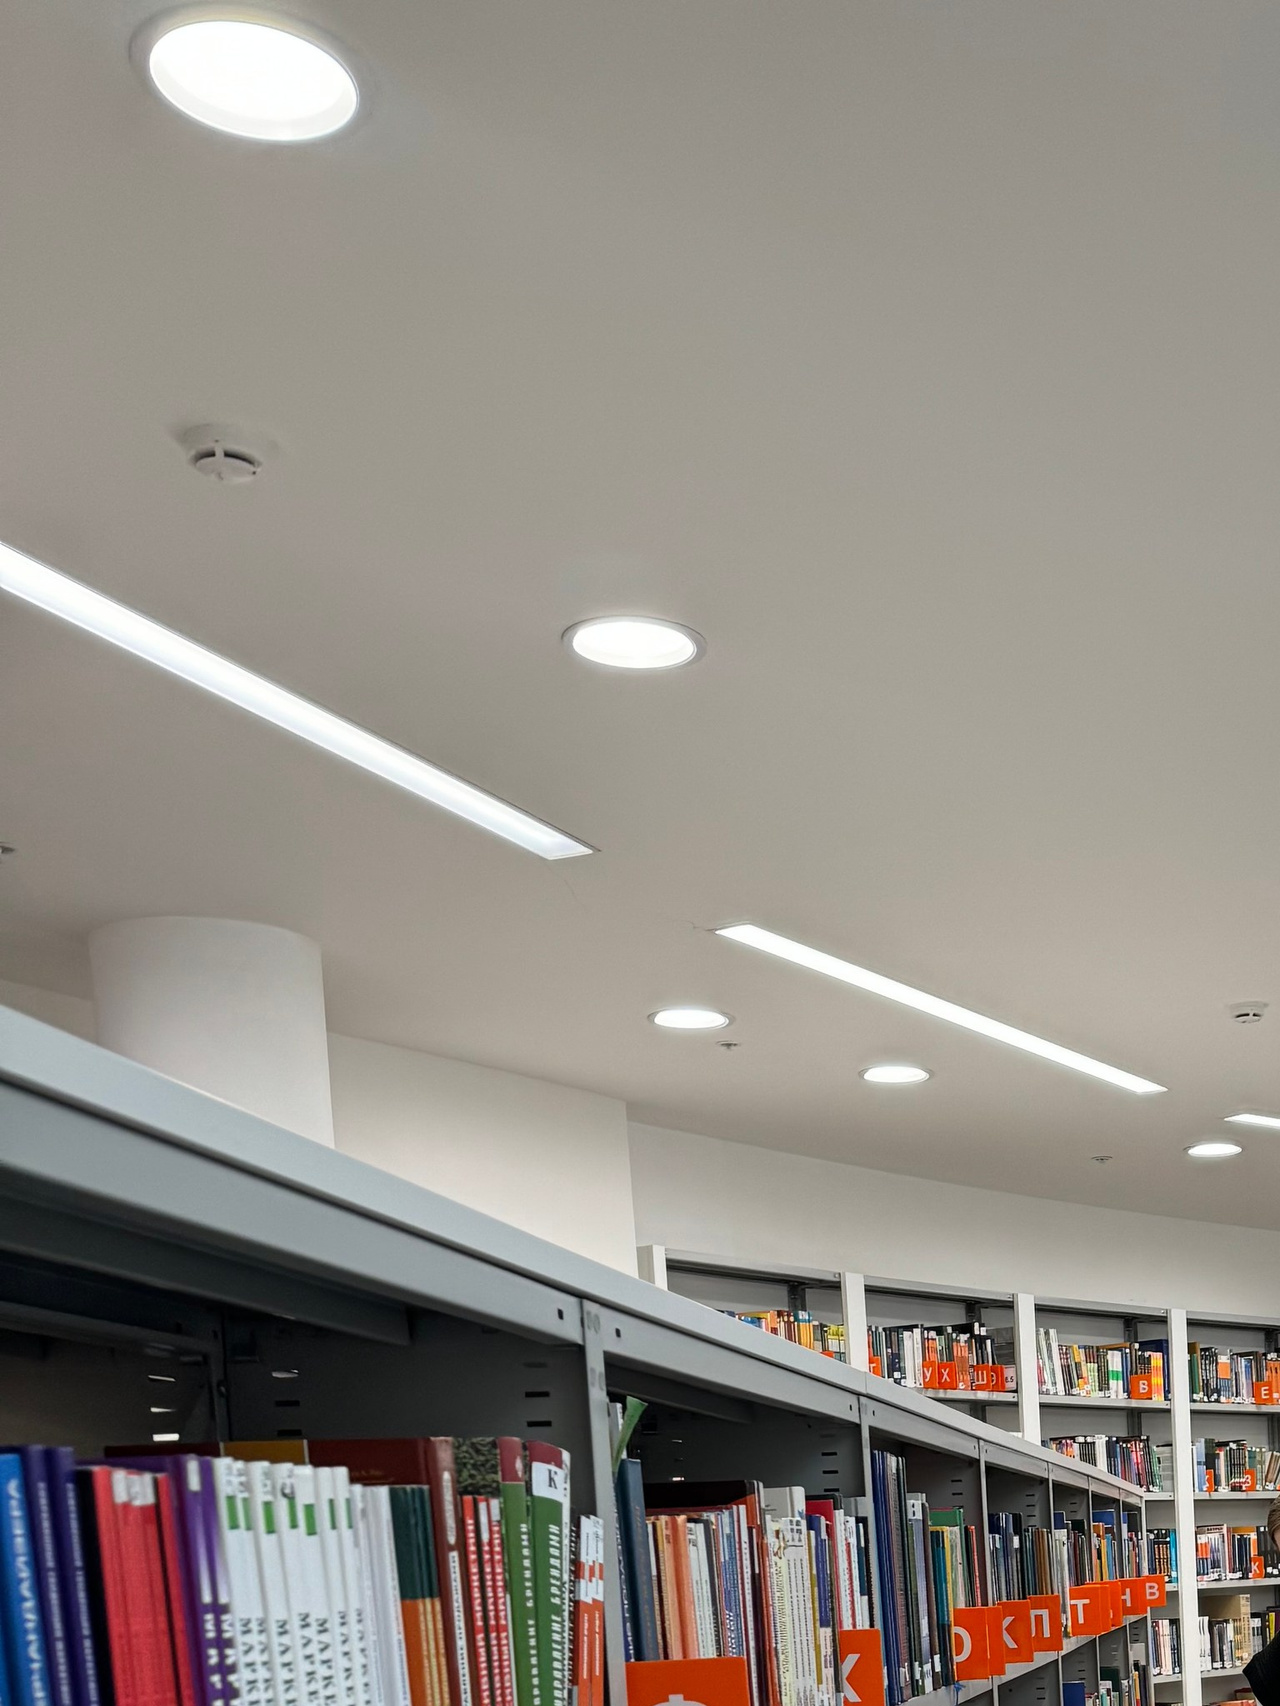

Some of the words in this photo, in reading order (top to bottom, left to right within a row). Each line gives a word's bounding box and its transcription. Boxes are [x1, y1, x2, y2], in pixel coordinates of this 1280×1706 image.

[941, 1368, 950, 1382] Х
[1139, 1380, 1148, 1393] В
[1261, 1387, 1270, 1399] Е
[548, 1469, 558, 1490] К
[548, 1524, 561, 1605] БРЕНДАМИ
[1145, 1582, 1160, 1600] В
[1070, 1599, 1090, 1624] Т
